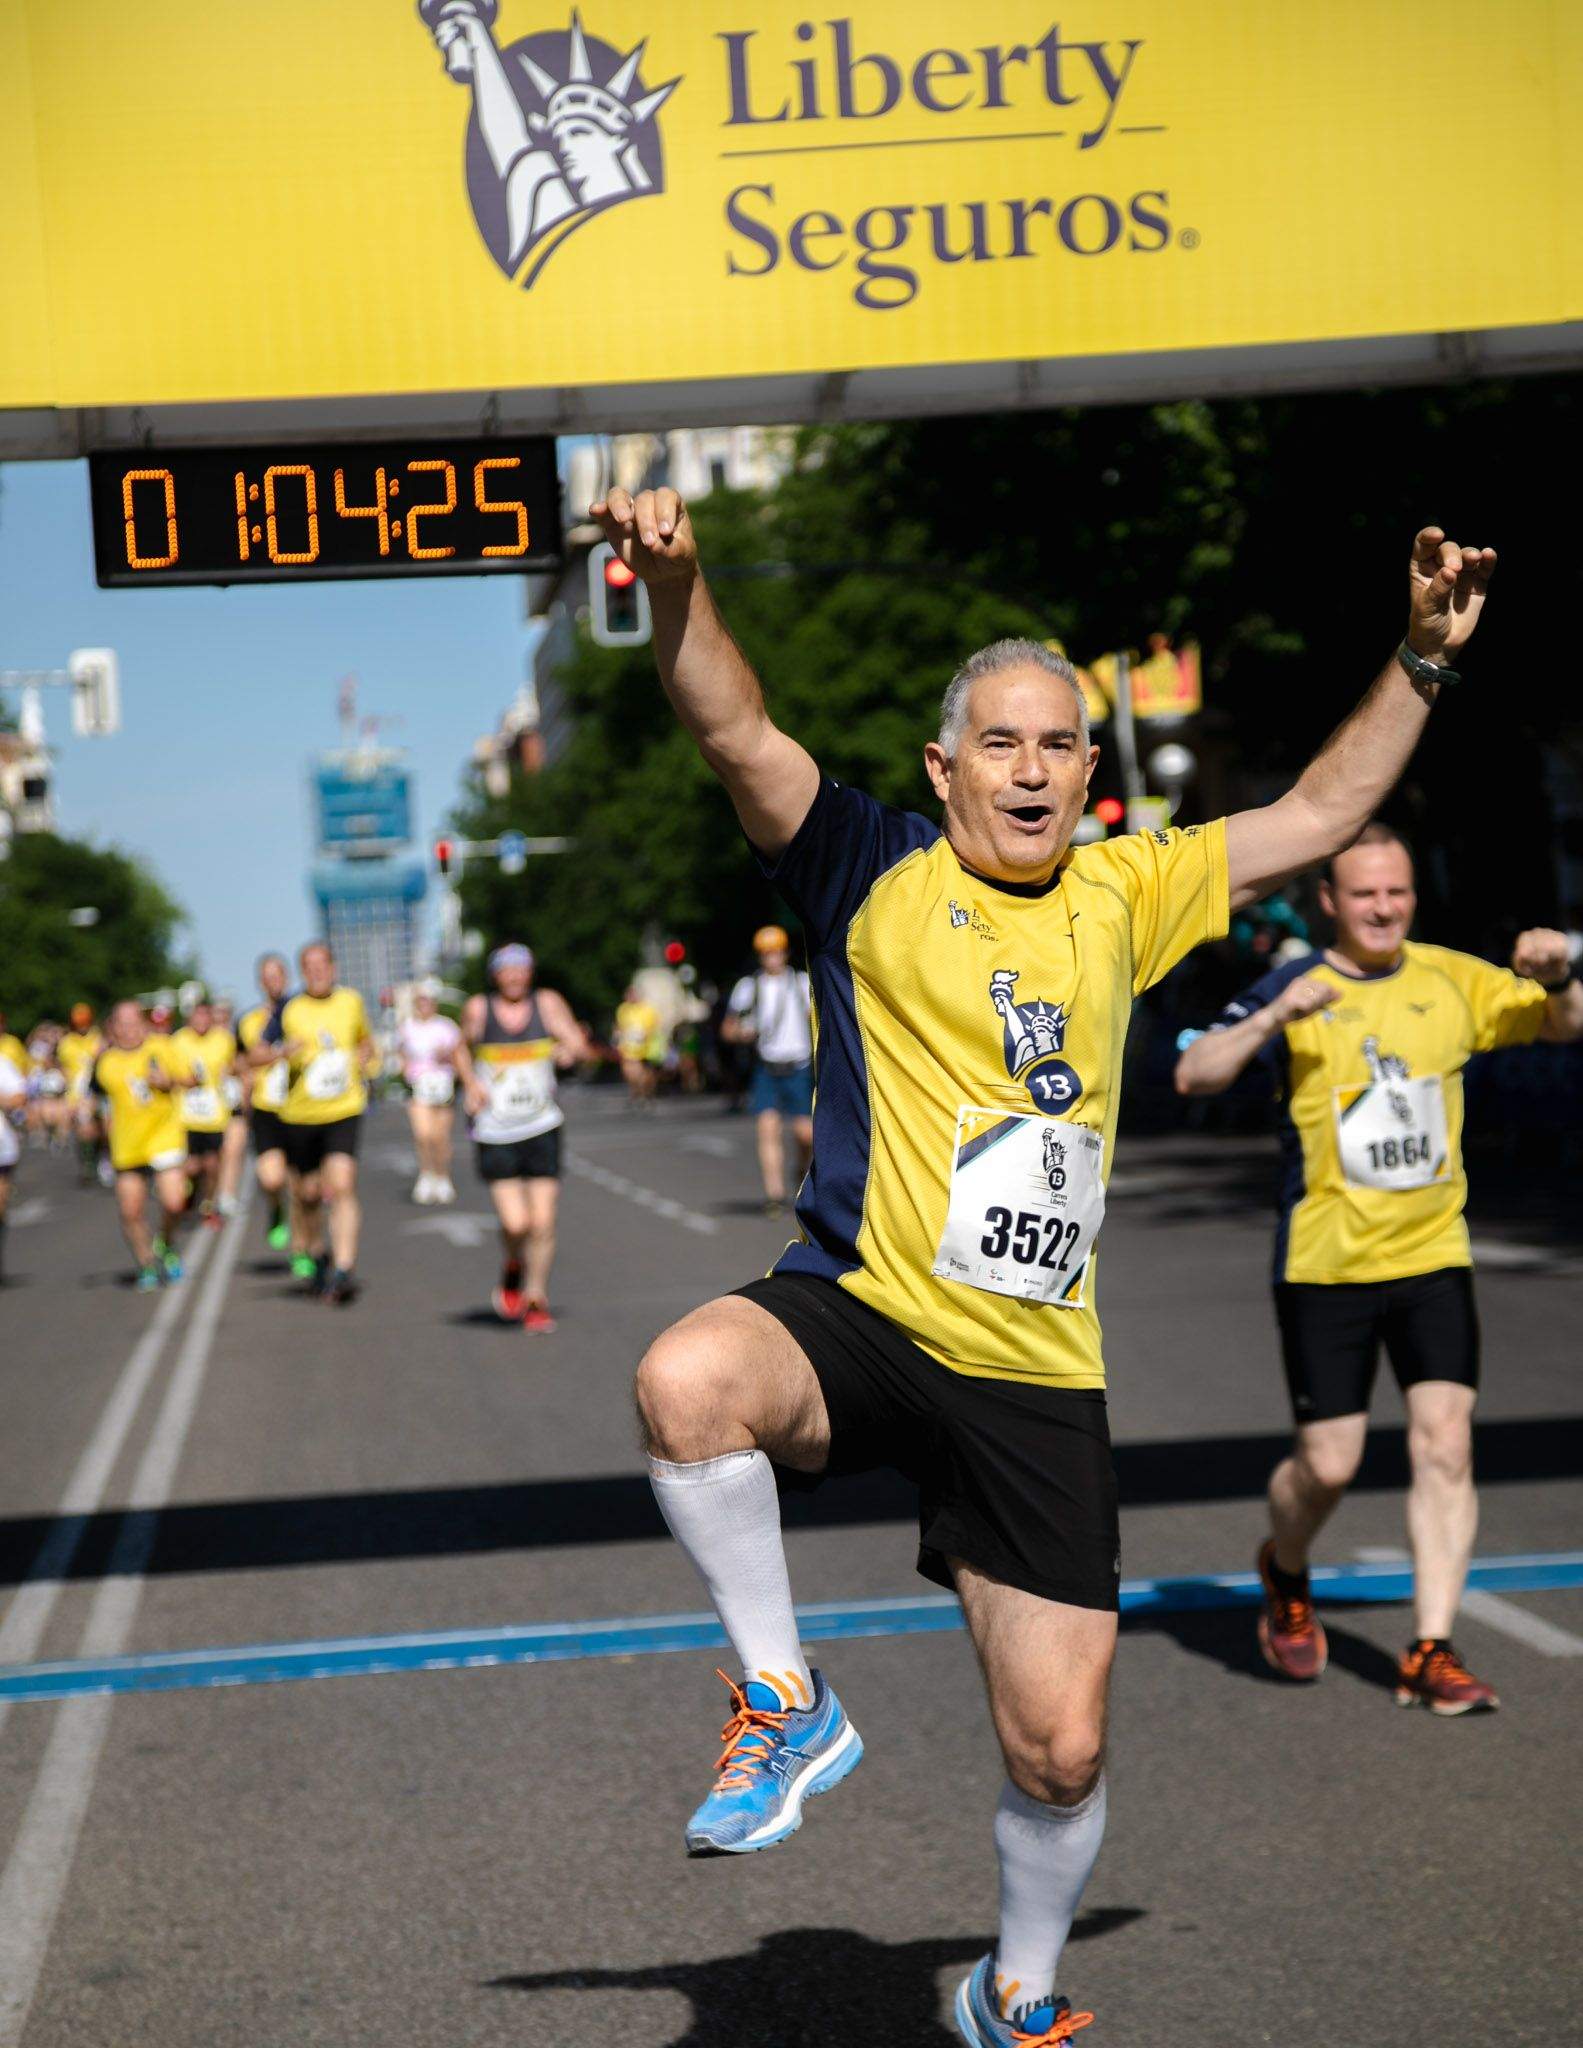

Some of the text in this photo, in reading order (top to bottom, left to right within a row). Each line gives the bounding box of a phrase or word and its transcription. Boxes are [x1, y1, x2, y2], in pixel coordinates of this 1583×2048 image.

[714, 18, 1143, 150] Liberty
[721, 183, 1172, 310] Seguros
[122, 457, 529, 569] 0 1:04:25
[1035, 1073, 1072, 1100] 13
[1051, 1172, 1064, 1186] 13
[1367, 1133, 1431, 1171] 1864
[980, 1205, 1081, 1272] 3522
